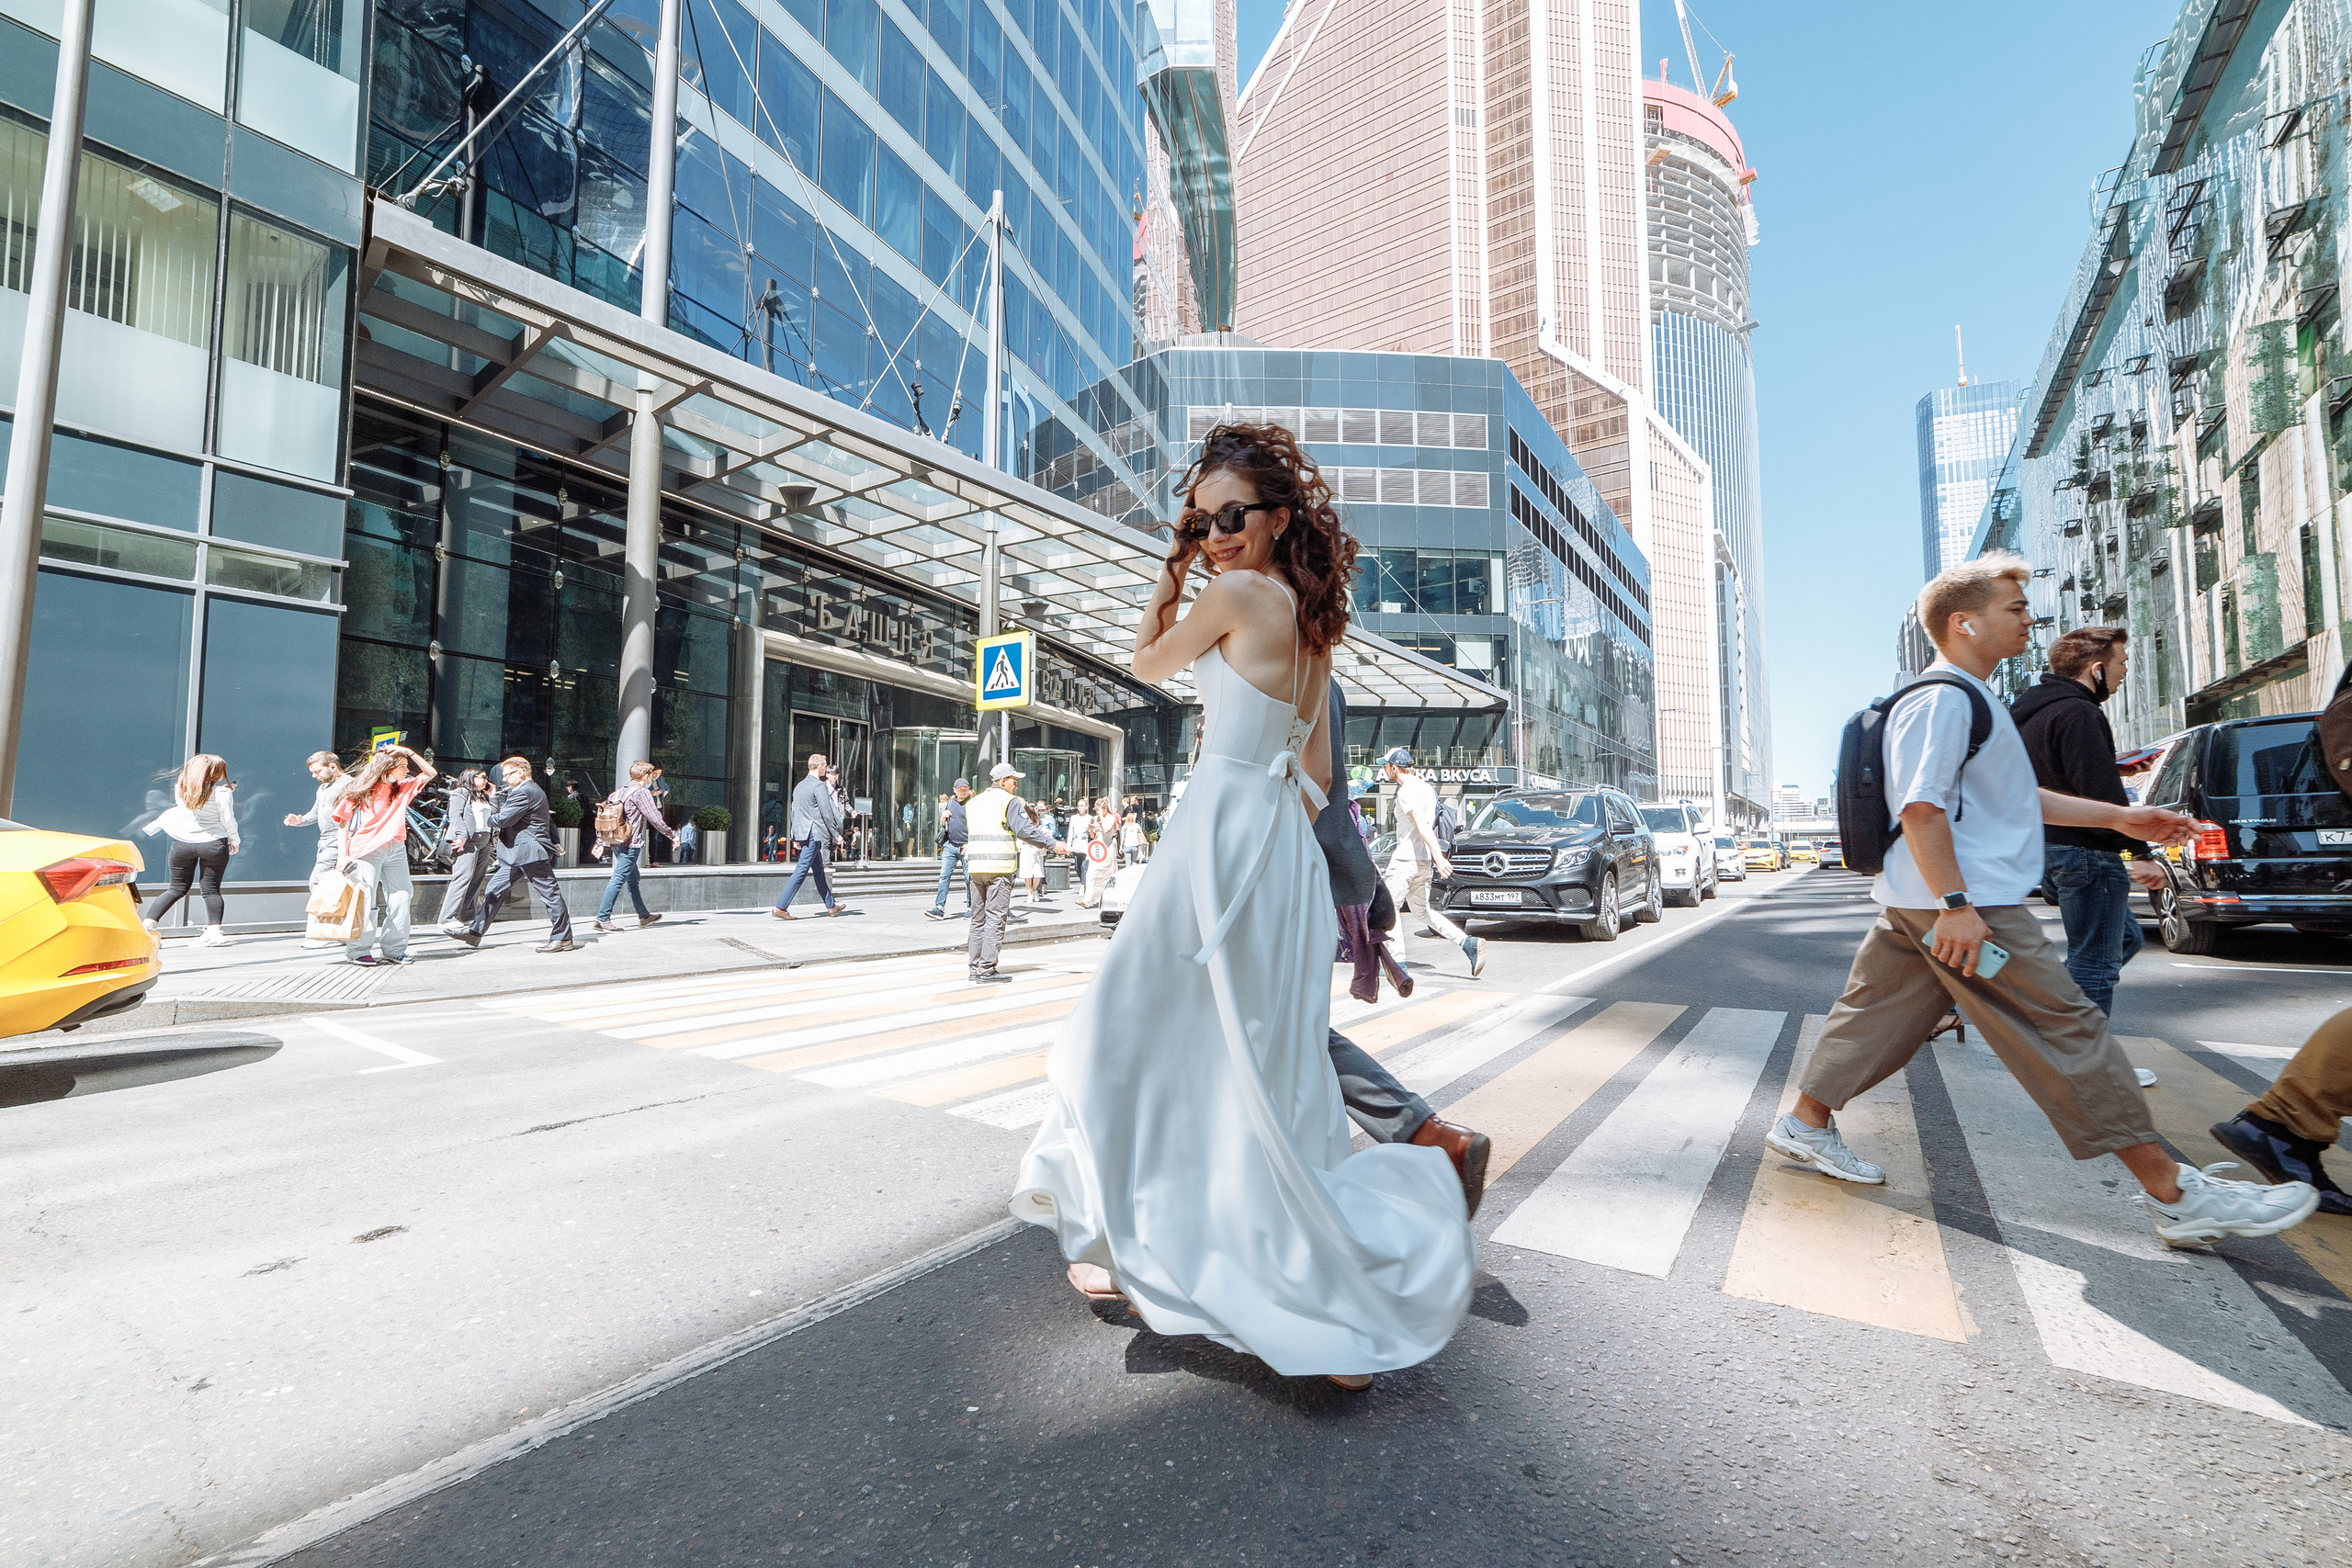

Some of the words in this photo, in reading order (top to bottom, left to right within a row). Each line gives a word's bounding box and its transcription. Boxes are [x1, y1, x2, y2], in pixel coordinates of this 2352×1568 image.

[816, 593, 934, 660] БАШНЯ
[1039, 670, 1095, 709] РАЦИЯ
[1376, 768, 1439, 783] АКА
[1440, 769, 1492, 783] ВКУСА
[2324, 830, 2352, 842] К7
